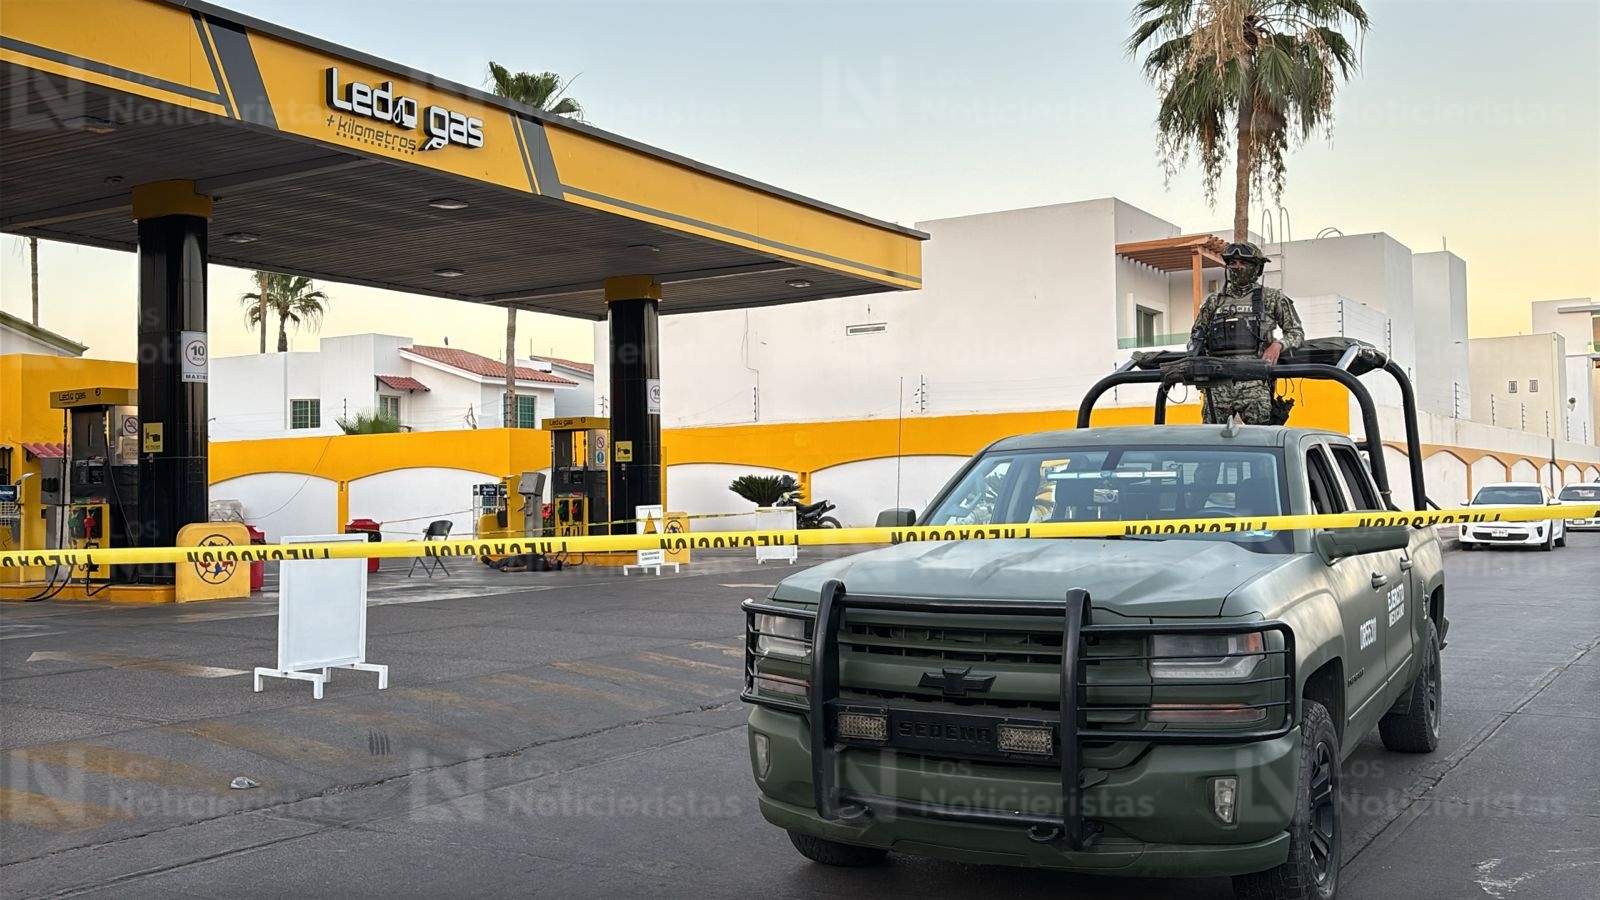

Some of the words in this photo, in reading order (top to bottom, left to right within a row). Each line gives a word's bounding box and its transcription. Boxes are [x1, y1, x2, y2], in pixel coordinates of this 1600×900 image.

[337, 115, 417, 150] kilometros
[424, 105, 484, 151] gas
[190, 345, 205, 357] 10
[899, 721, 992, 744] SEDENA
